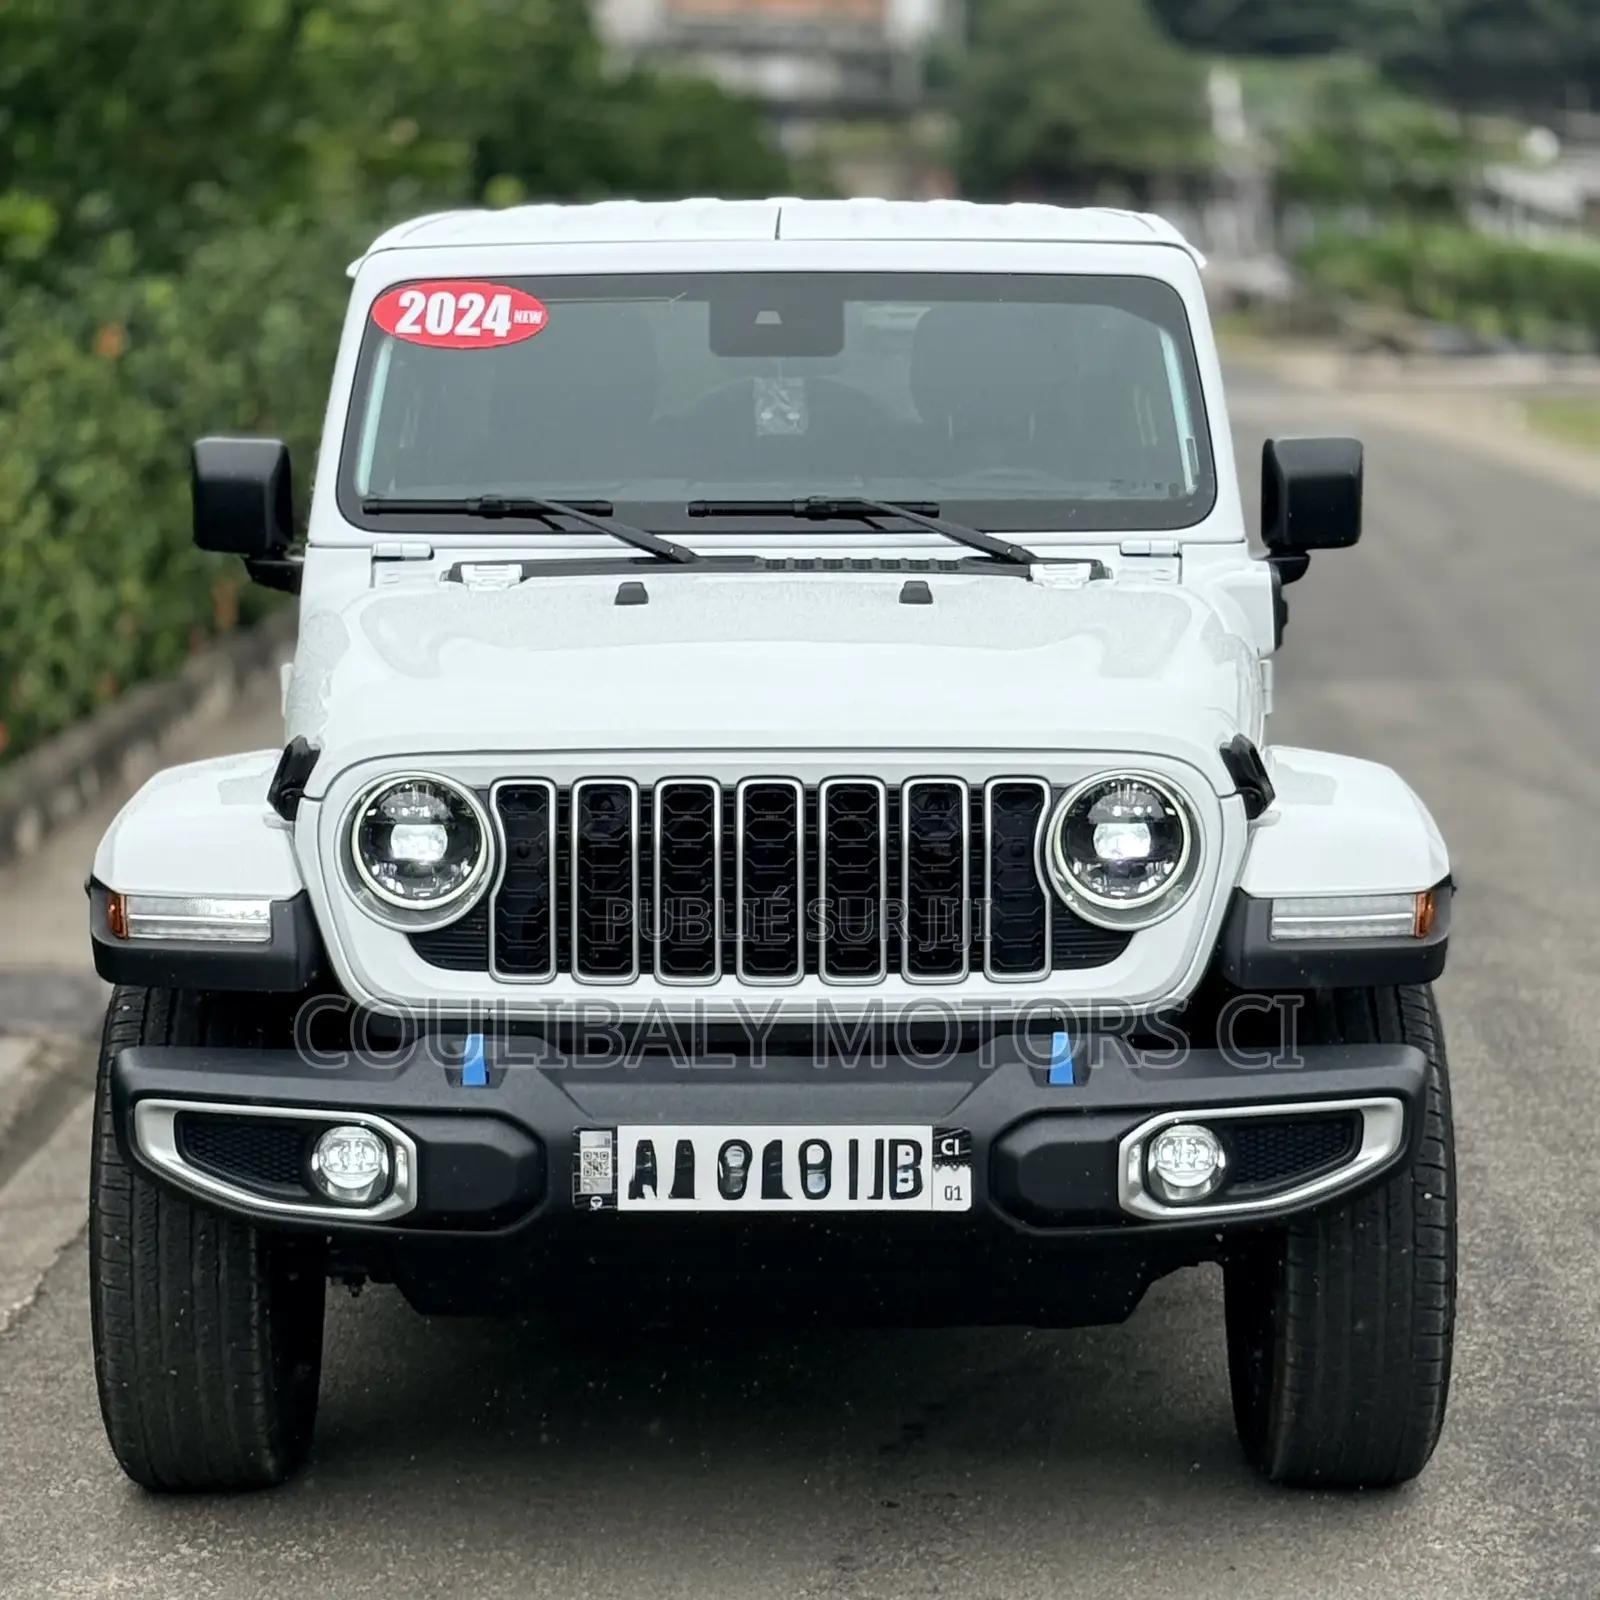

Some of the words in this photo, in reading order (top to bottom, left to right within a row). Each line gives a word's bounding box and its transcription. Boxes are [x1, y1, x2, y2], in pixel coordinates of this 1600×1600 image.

[395, 290, 512, 338] 2024
[513, 309, 543, 325] NEW
[941, 1138, 960, 1156] CI
[944, 1185, 963, 1201] 01
